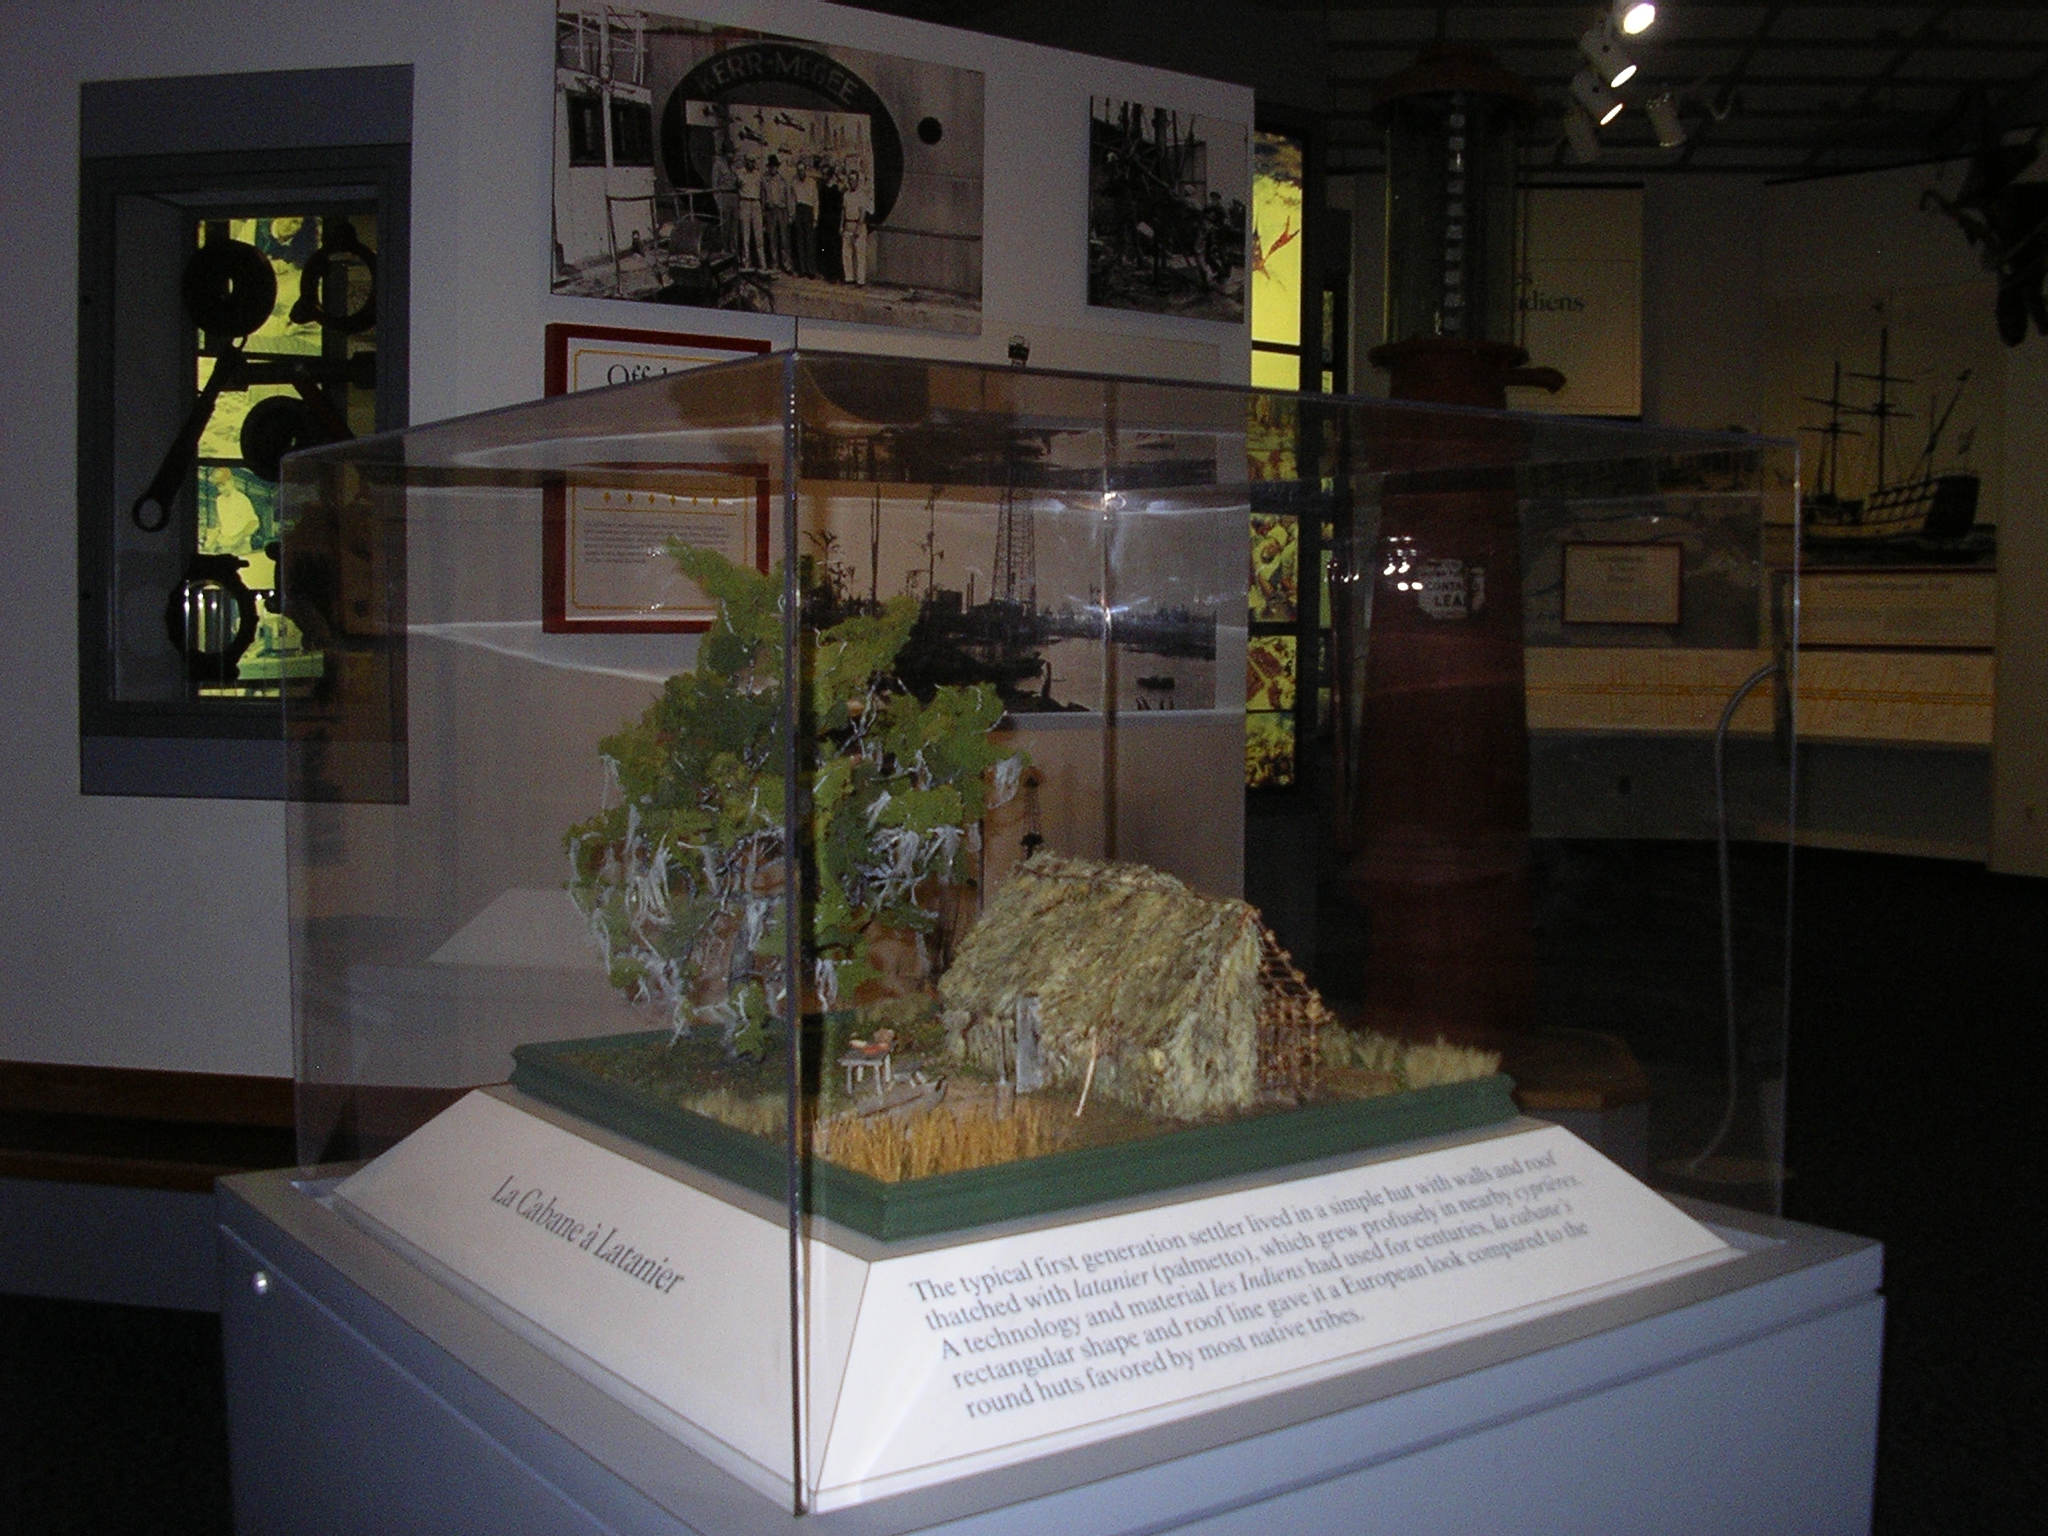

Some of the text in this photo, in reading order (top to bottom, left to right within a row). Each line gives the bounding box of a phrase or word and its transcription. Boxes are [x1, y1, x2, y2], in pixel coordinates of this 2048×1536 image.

[490, 1175, 516, 1208] La
[516, 1188, 585, 1243] Cabane
[593, 1228, 685, 1295] Latanier
[908, 1279, 956, 1302] The
[959, 1260, 1033, 1296] typical
[1034, 1256, 1079, 1278] first
[1081, 1233, 1187, 1271] generation
[1190, 1220, 1244, 1245] settler
[1244, 1207, 1293, 1232] lived
[1294, 1205, 1313, 1223] in
[1317, 1205, 1328, 1219] a
[1329, 1189, 1385, 1214] simple
[1382, 1184, 1415, 1203] hut
[1415, 1174, 1453, 1195] with
[1452, 1164, 1493, 1186] walls
[1494, 1157, 1524, 1179] and
[924, 1293, 1021, 1331] thatched
[1024, 1283, 1071, 1310] with
[1074, 1267, 1149, 1299] latanier
[1152, 1245, 1260, 1285] (palmetto),
[1260, 1231, 1316, 1256] which
[1317, 1225, 1358, 1249] grew
[1361, 1202, 1440, 1240] profusely
[1439, 1201, 1456, 1217] in
[1459, 1187, 1513, 1213] nearby
[941, 1338, 961, 1359] A
[964, 1314, 1081, 1354] technology
[1085, 1301, 1125, 1327] and
[1127, 1281, 1210, 1317] material
[1211, 1277, 1237, 1298] les
[1240, 1266, 1306, 1292] Indiens
[1305, 1253, 1343, 1276] had
[1343, 1241, 1385, 1267] used
[1383, 1237, 1412, 1257] for
[1413, 1220, 1493, 1250] centuries,
[1491, 1213, 1508, 1231] la
[951, 1220, 1589, 1389] rectangular shape and roof line gave it a European look compared to the
[966, 1307, 1365, 1418] round huts favored by most native tribes.
